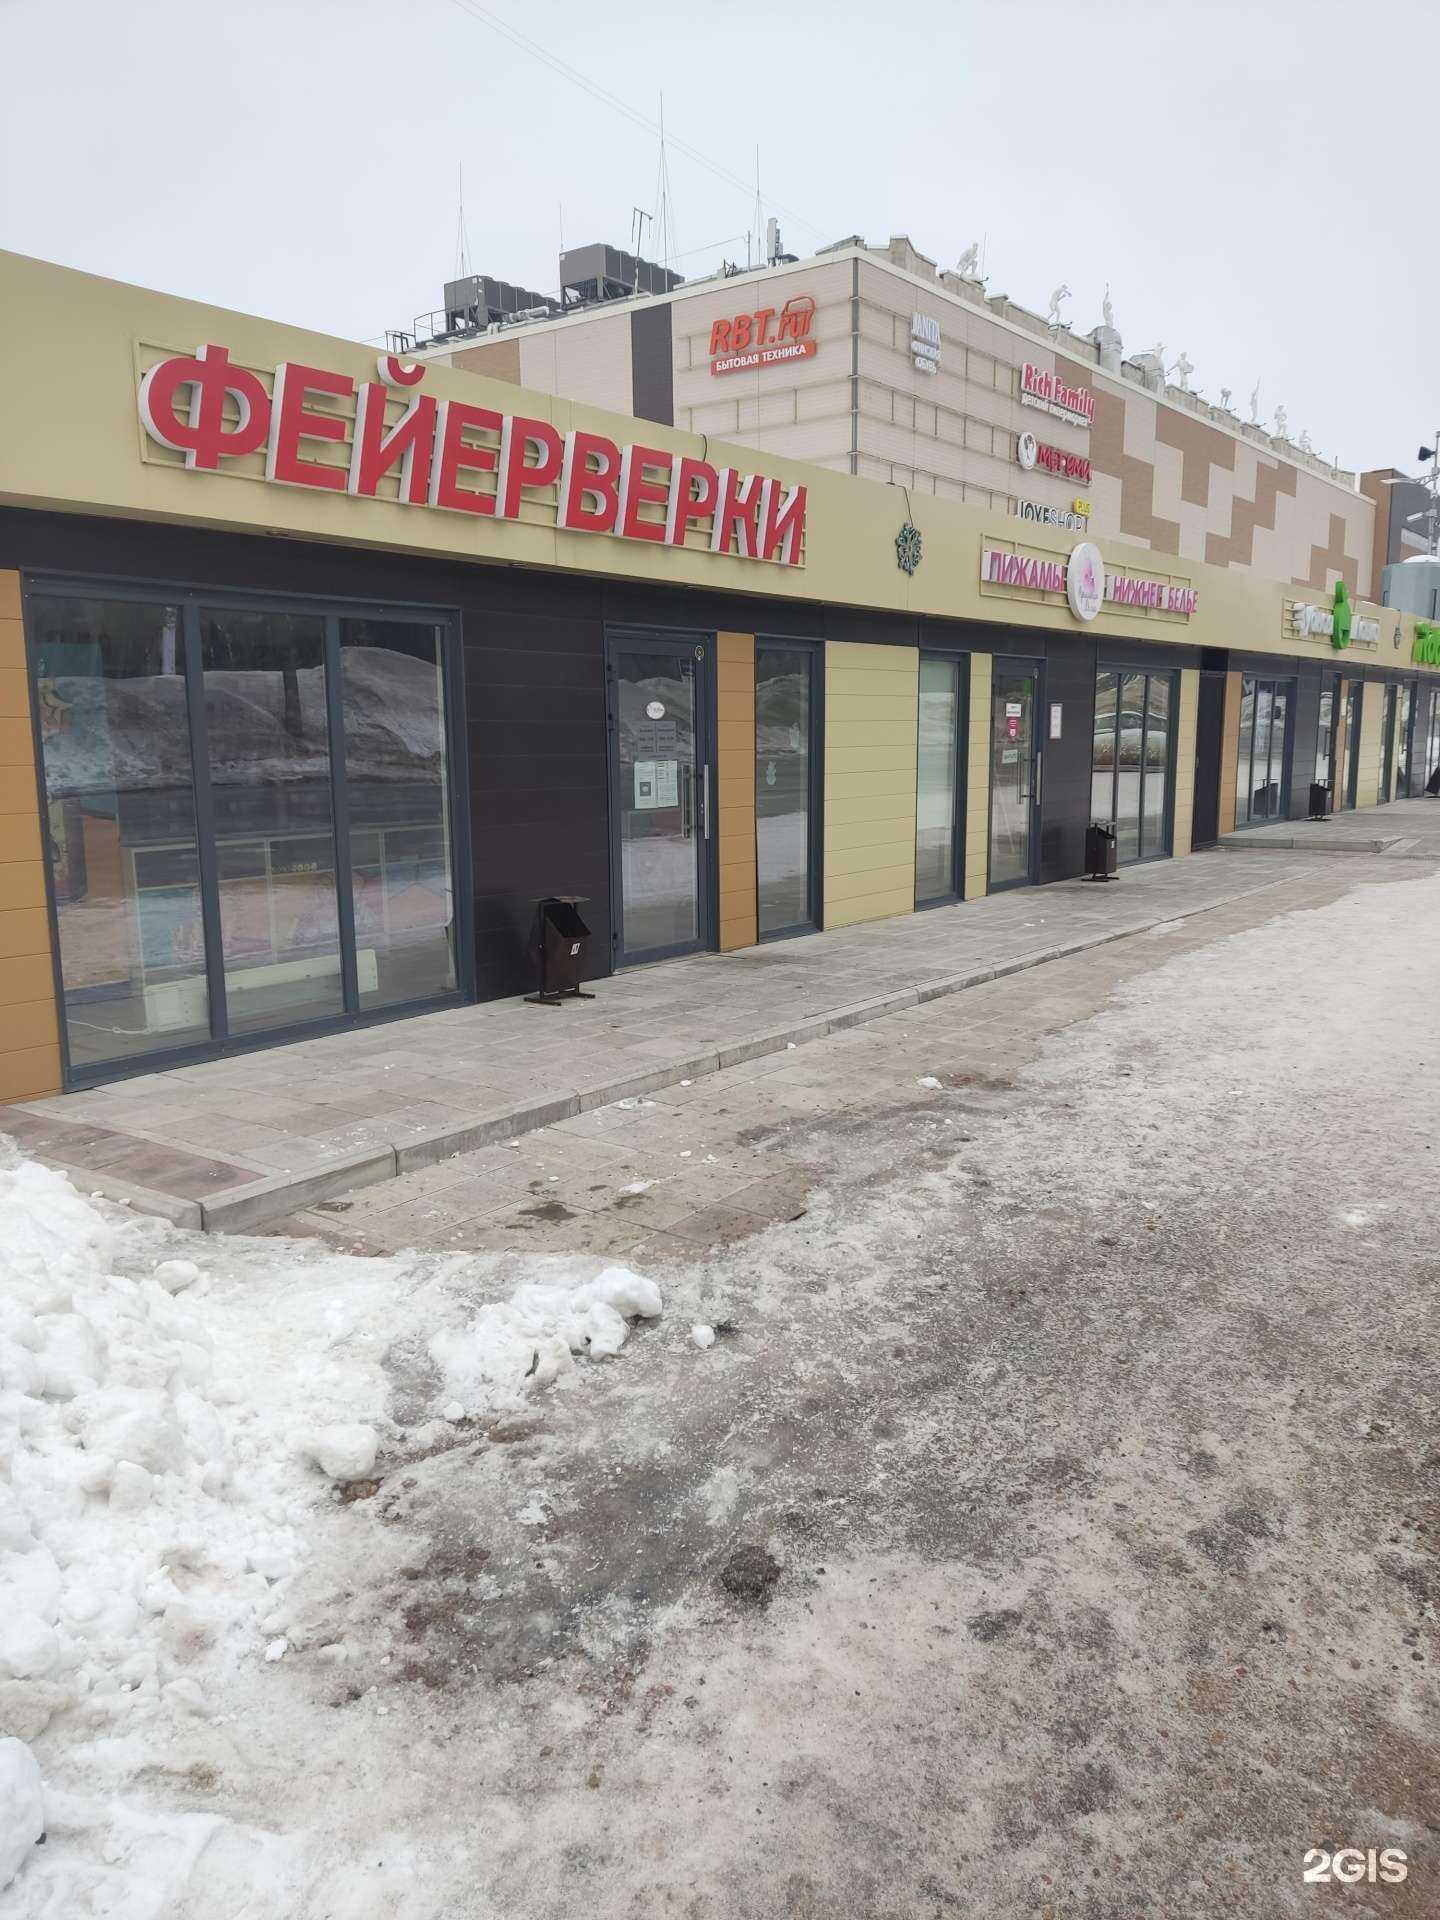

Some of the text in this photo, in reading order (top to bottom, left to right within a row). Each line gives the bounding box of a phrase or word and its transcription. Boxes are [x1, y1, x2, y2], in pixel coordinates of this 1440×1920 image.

[709, 303, 814, 355] RBT.ru
[716, 344, 806, 371] БЫТОВАЯ ТЕХНИКА
[1022, 363, 1094, 424] Rich Family
[139, 343, 807, 566] ФЕЙЕРВЕРКИ
[984, 551, 1066, 593] ПИЖАМЫ
[1167, 586, 1199, 614] БЕЛЬЕ
